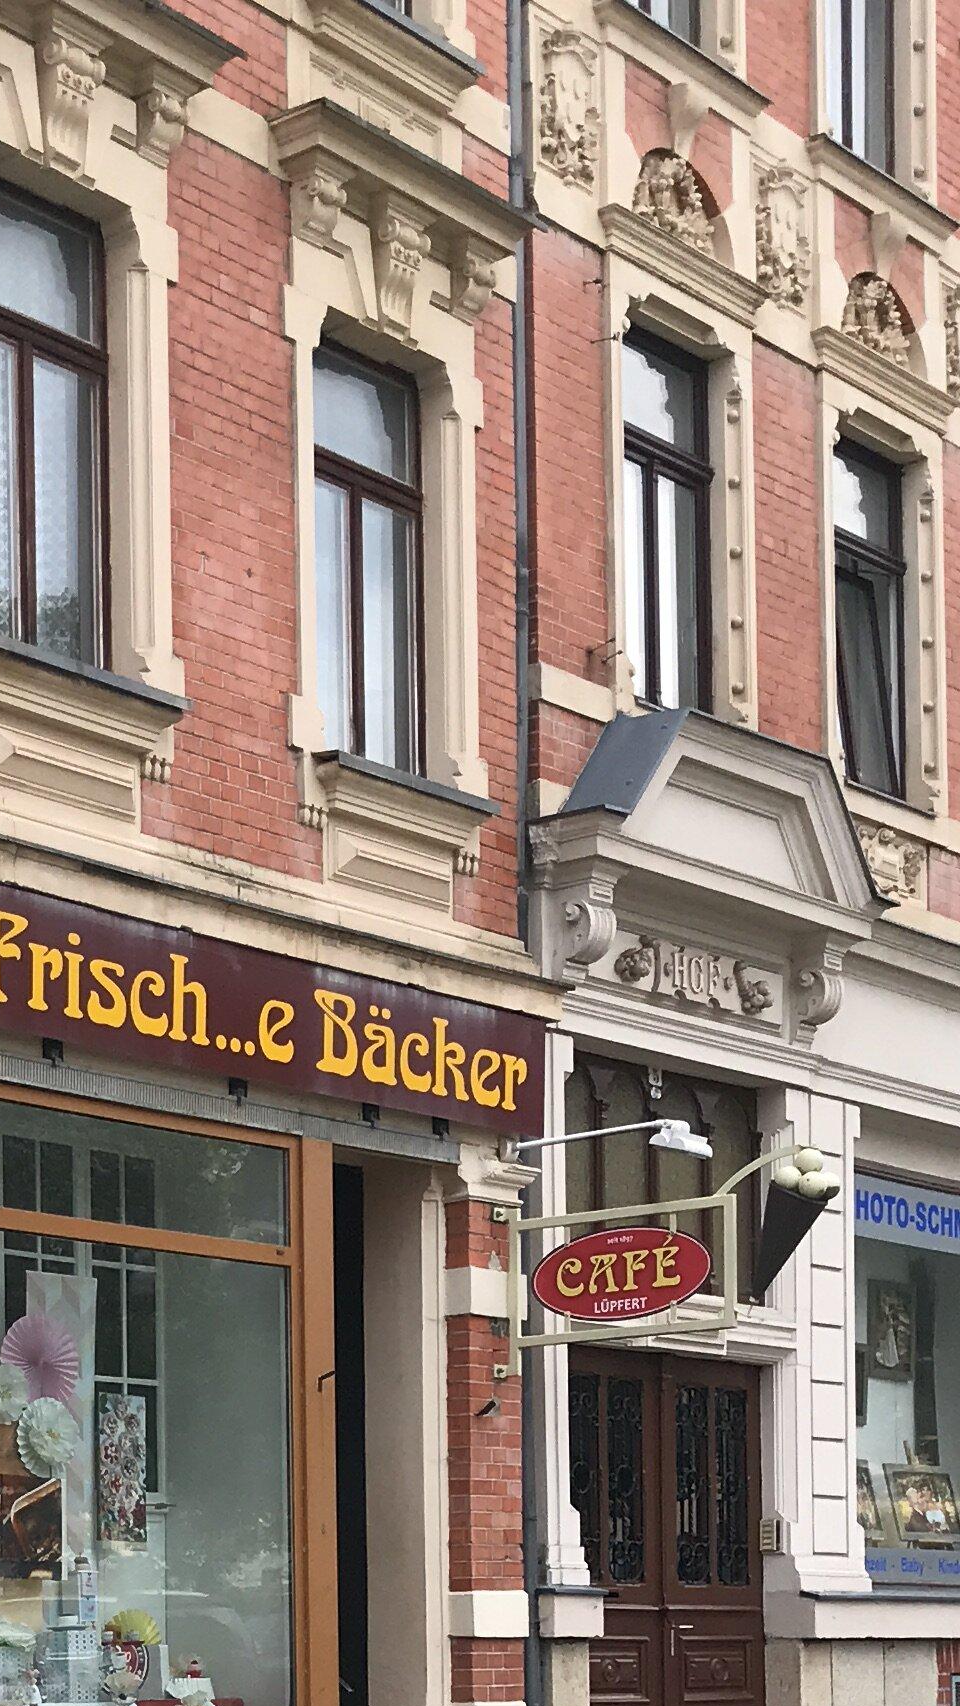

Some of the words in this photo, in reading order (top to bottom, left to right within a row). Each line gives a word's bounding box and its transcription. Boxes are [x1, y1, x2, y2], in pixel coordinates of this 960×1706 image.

[313, 989, 528, 1111] Bäcker
[556, 1234, 682, 1297] CAFÉ
[594, 1296, 648, 1314] LÜPFERT
